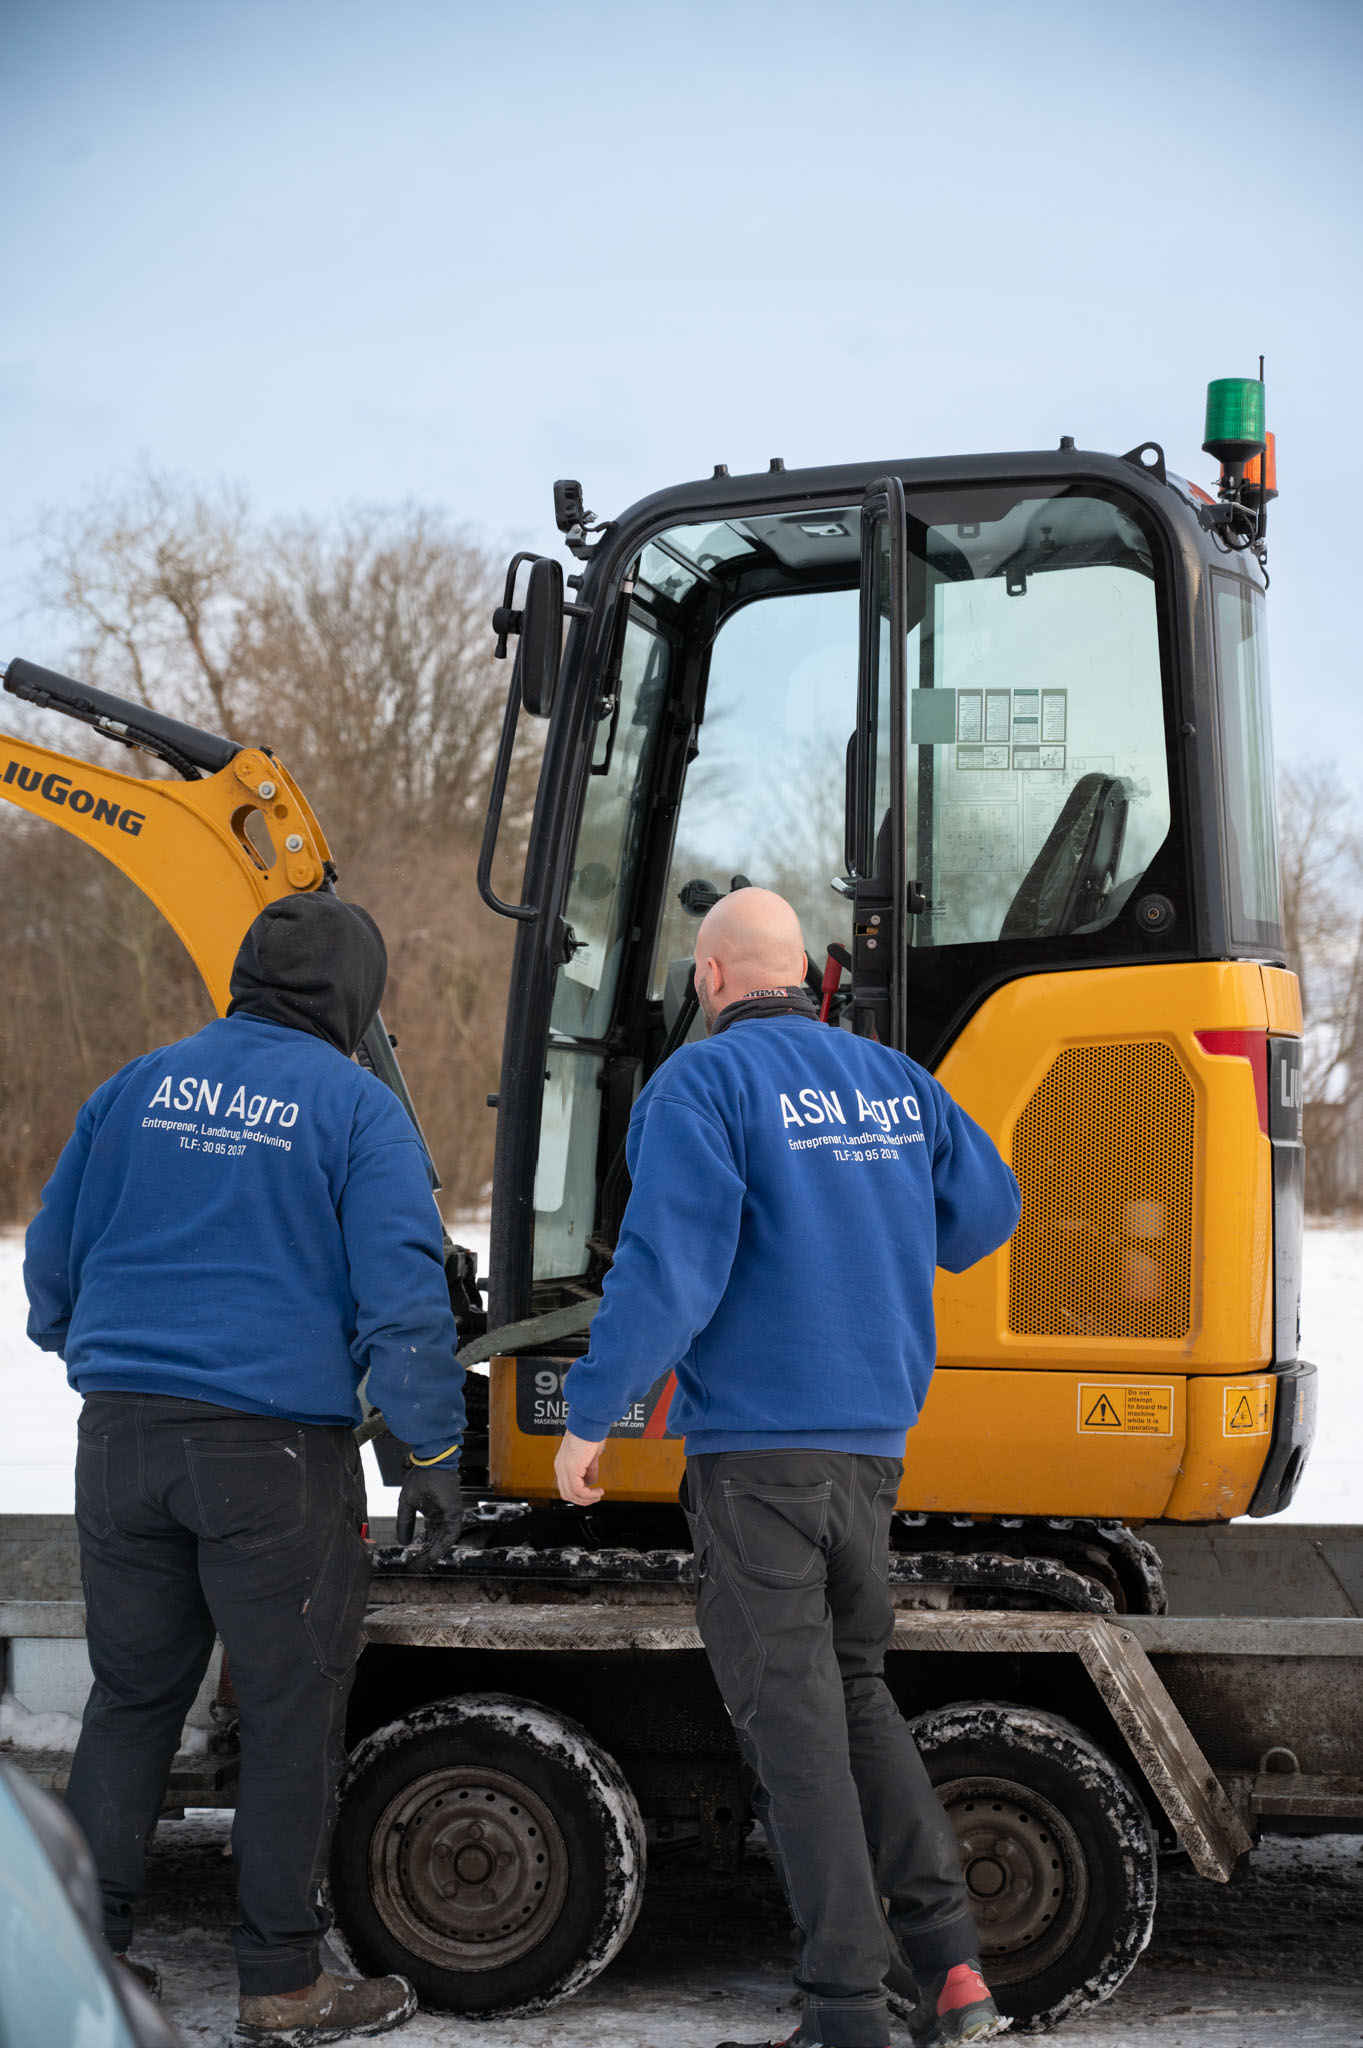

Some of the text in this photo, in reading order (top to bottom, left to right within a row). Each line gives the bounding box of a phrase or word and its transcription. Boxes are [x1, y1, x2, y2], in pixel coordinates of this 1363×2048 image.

[0, 760, 146, 837] IUGONG
[148, 1075, 299, 1128] ASN Agro
[779, 1088, 921, 1133] ASN Agro
[141, 1117, 199, 1135] Entreprenør,
[241, 1128, 293, 1152] Nedrivning
[179, 1136, 247, 1156] TLF: 30 95 2037
[886, 1131, 926, 1146] Nedrivnin
[832, 1150, 853, 1161] TLF:
[852, 1150, 864, 1162] 30
[864, 1148, 879, 1161] 95
